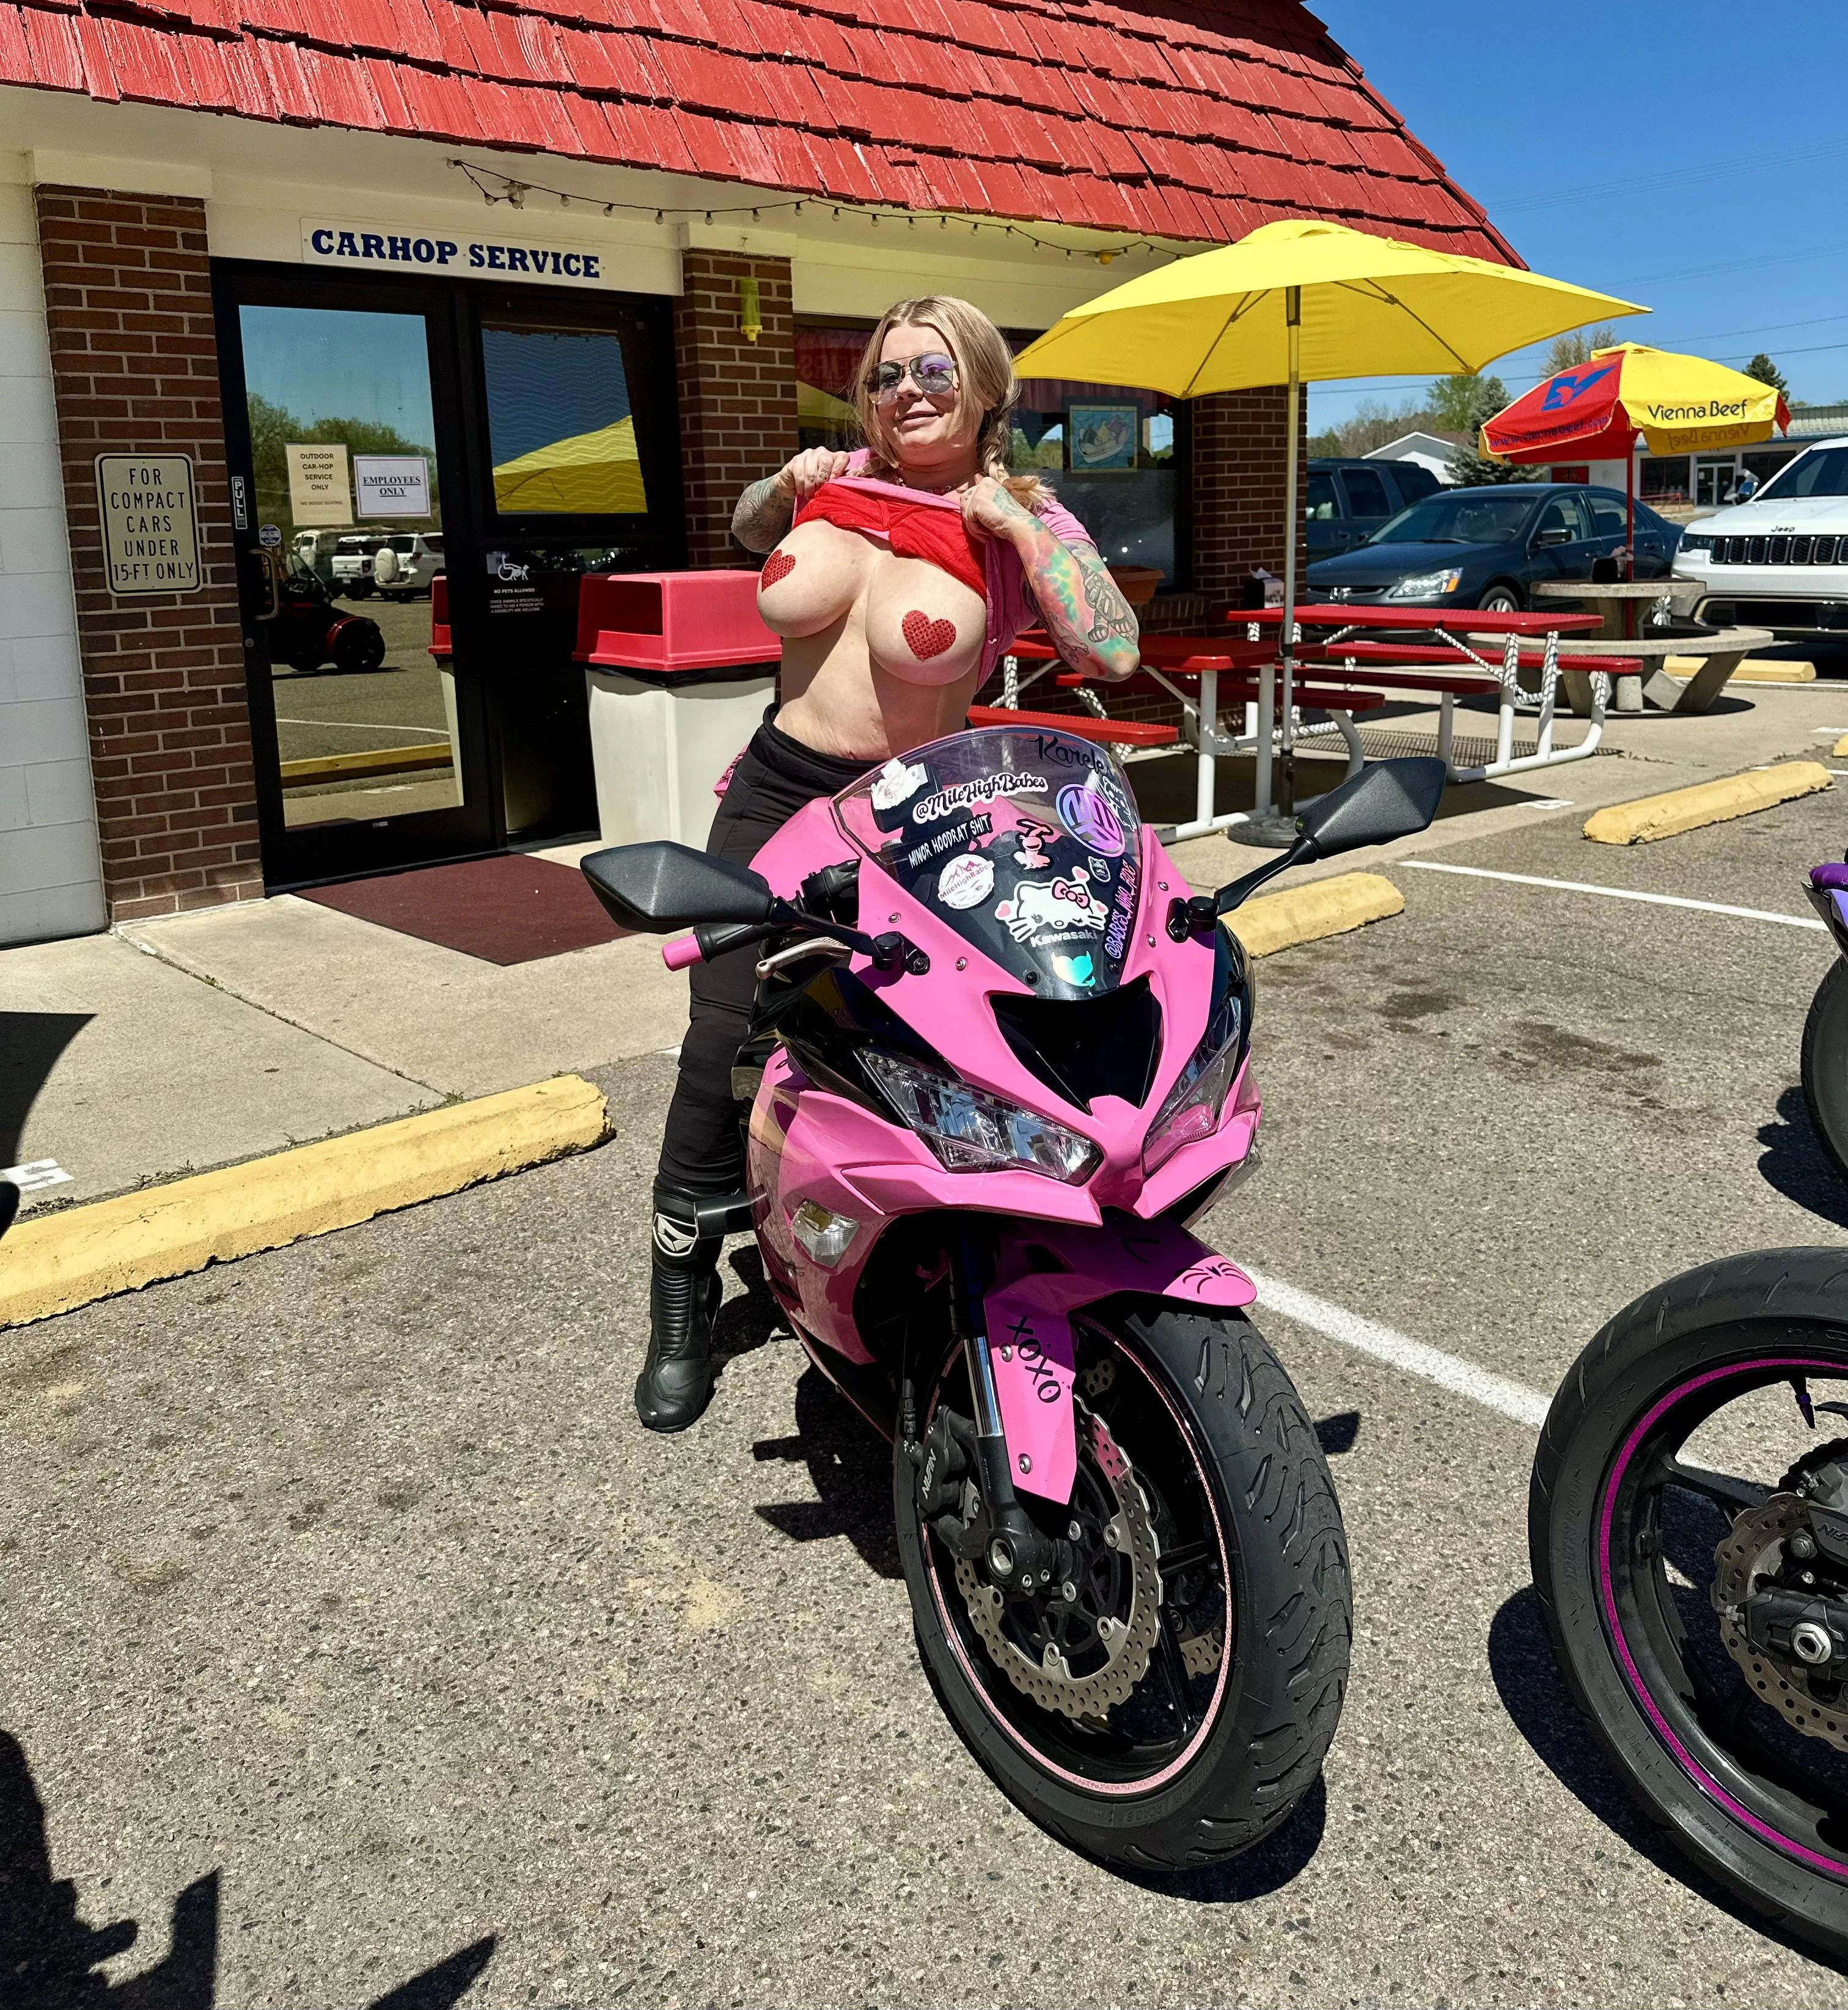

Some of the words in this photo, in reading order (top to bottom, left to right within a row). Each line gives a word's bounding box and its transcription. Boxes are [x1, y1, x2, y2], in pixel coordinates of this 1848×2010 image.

[311, 229, 458, 265] CARHOP
[469, 243, 600, 278] SERVICE
[1647, 404, 1706, 420] Vienna
[1710, 399, 1748, 419] Beef
[129, 468, 162, 485] FOR
[111, 491, 185, 509] COMPACT
[234, 481, 244, 516] PULL
[127, 515, 172, 533] CARS
[124, 539, 179, 557] UNDER
[156, 562, 194, 579] ONLY
[916, 773, 1046, 818] @MileHighBabes
[908, 842, 933, 868] MINOR
[931, 823, 969, 854] HOODRAT
[970, 815, 991, 835] SHIT
[940, 862, 992, 899] MileHighBabes
[1030, 929, 1098, 948] Kawasaki
[1006, 1315, 1062, 1403] XOXO
